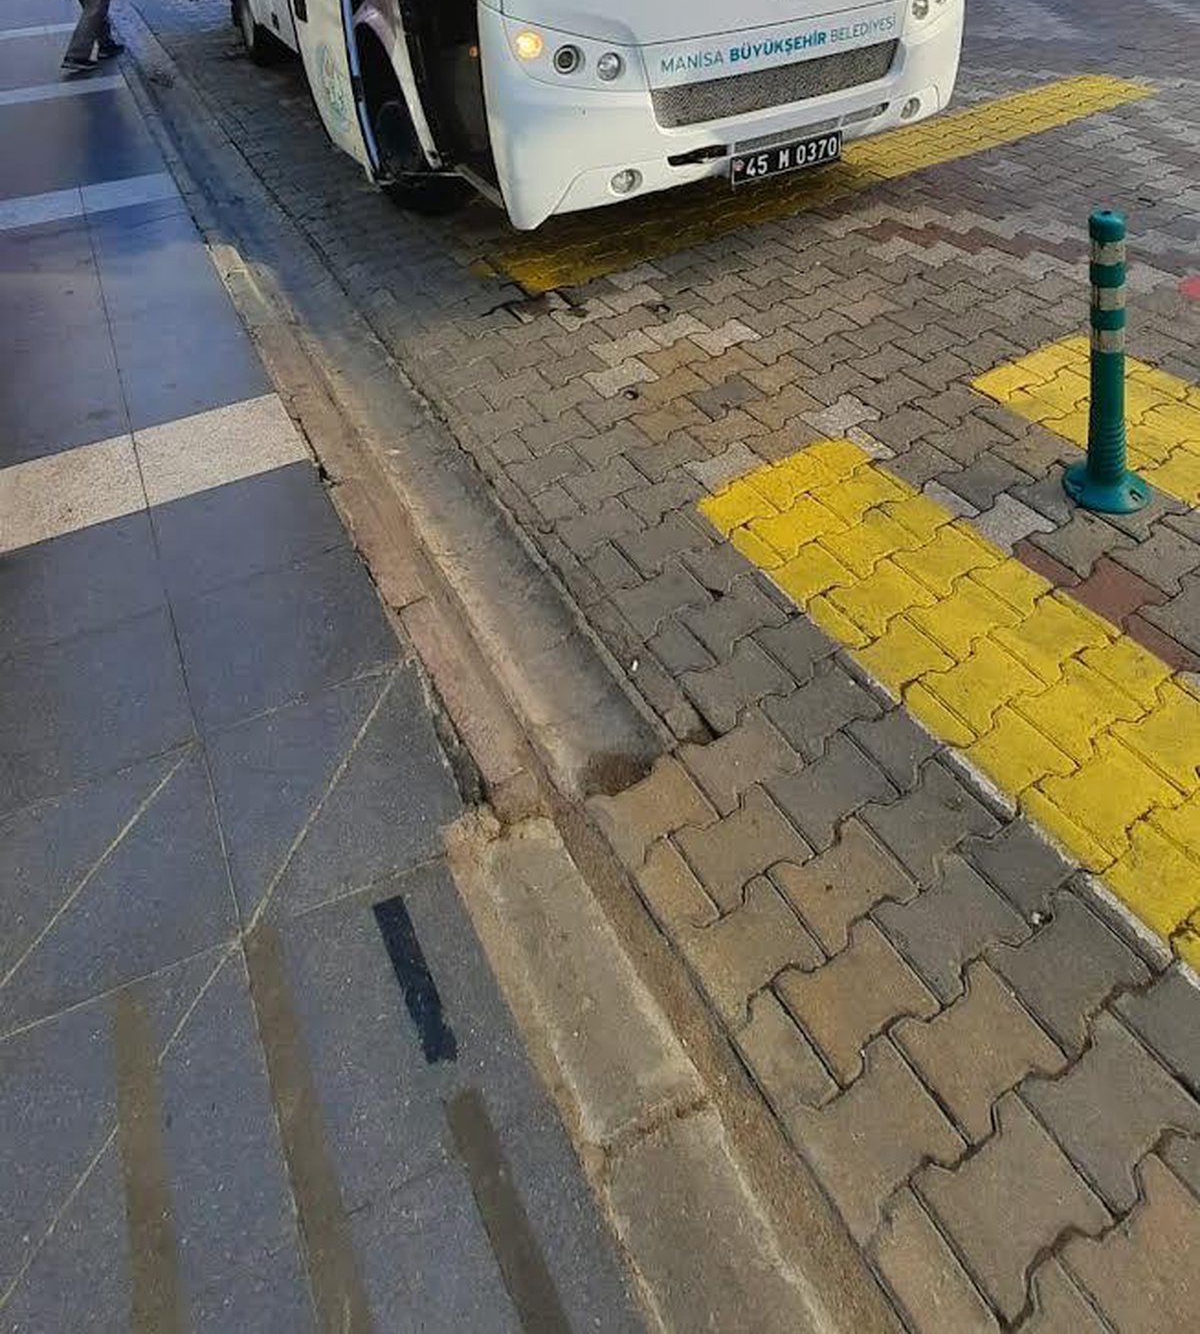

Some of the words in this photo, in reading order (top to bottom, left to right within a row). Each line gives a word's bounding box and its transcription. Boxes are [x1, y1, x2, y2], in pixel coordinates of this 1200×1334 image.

[728, 29, 827, 63] BÜYÜKŞEHİR
[746, 153, 769, 177] 45
[778, 149, 790, 169] M
[796, 136, 837, 164] 0370
